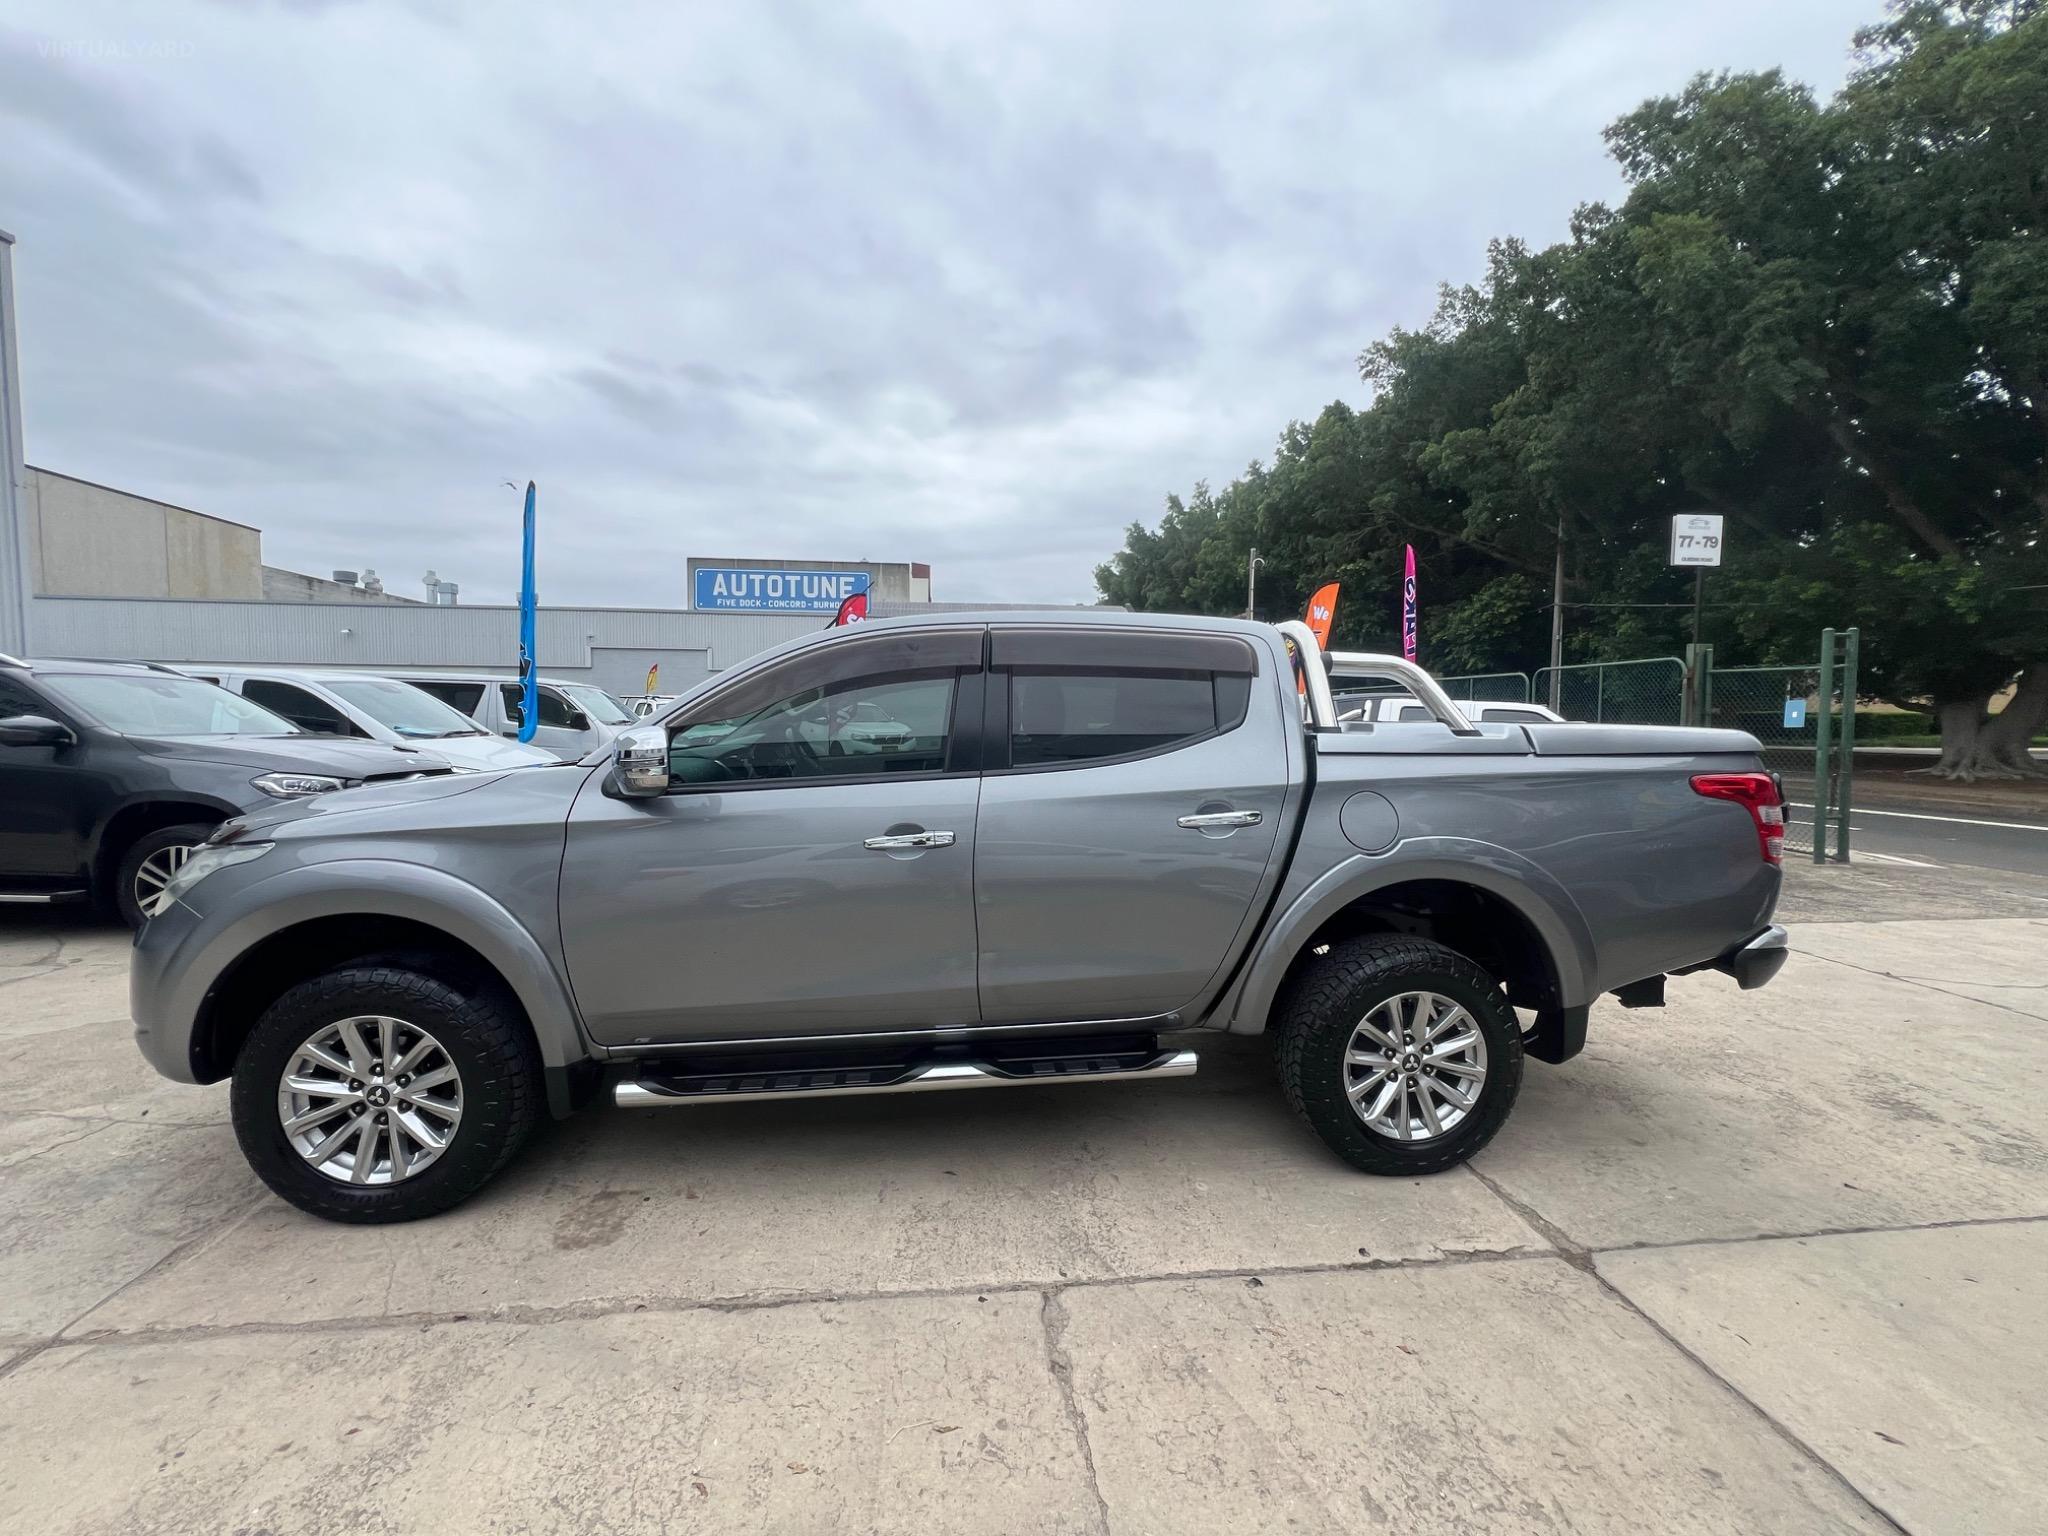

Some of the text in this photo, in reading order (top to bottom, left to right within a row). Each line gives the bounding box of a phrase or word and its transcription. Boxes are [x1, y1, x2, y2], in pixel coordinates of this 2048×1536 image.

[1679, 535, 1694, 548] 77
[1702, 536, 1719, 549] 79
[713, 573, 855, 598] AUTOTUNE
[716, 598, 737, 607] FIVE
[739, 598, 762, 608] DOCK
[768, 600, 807, 609] CONCORD
[1313, 605, 1329, 620] We
